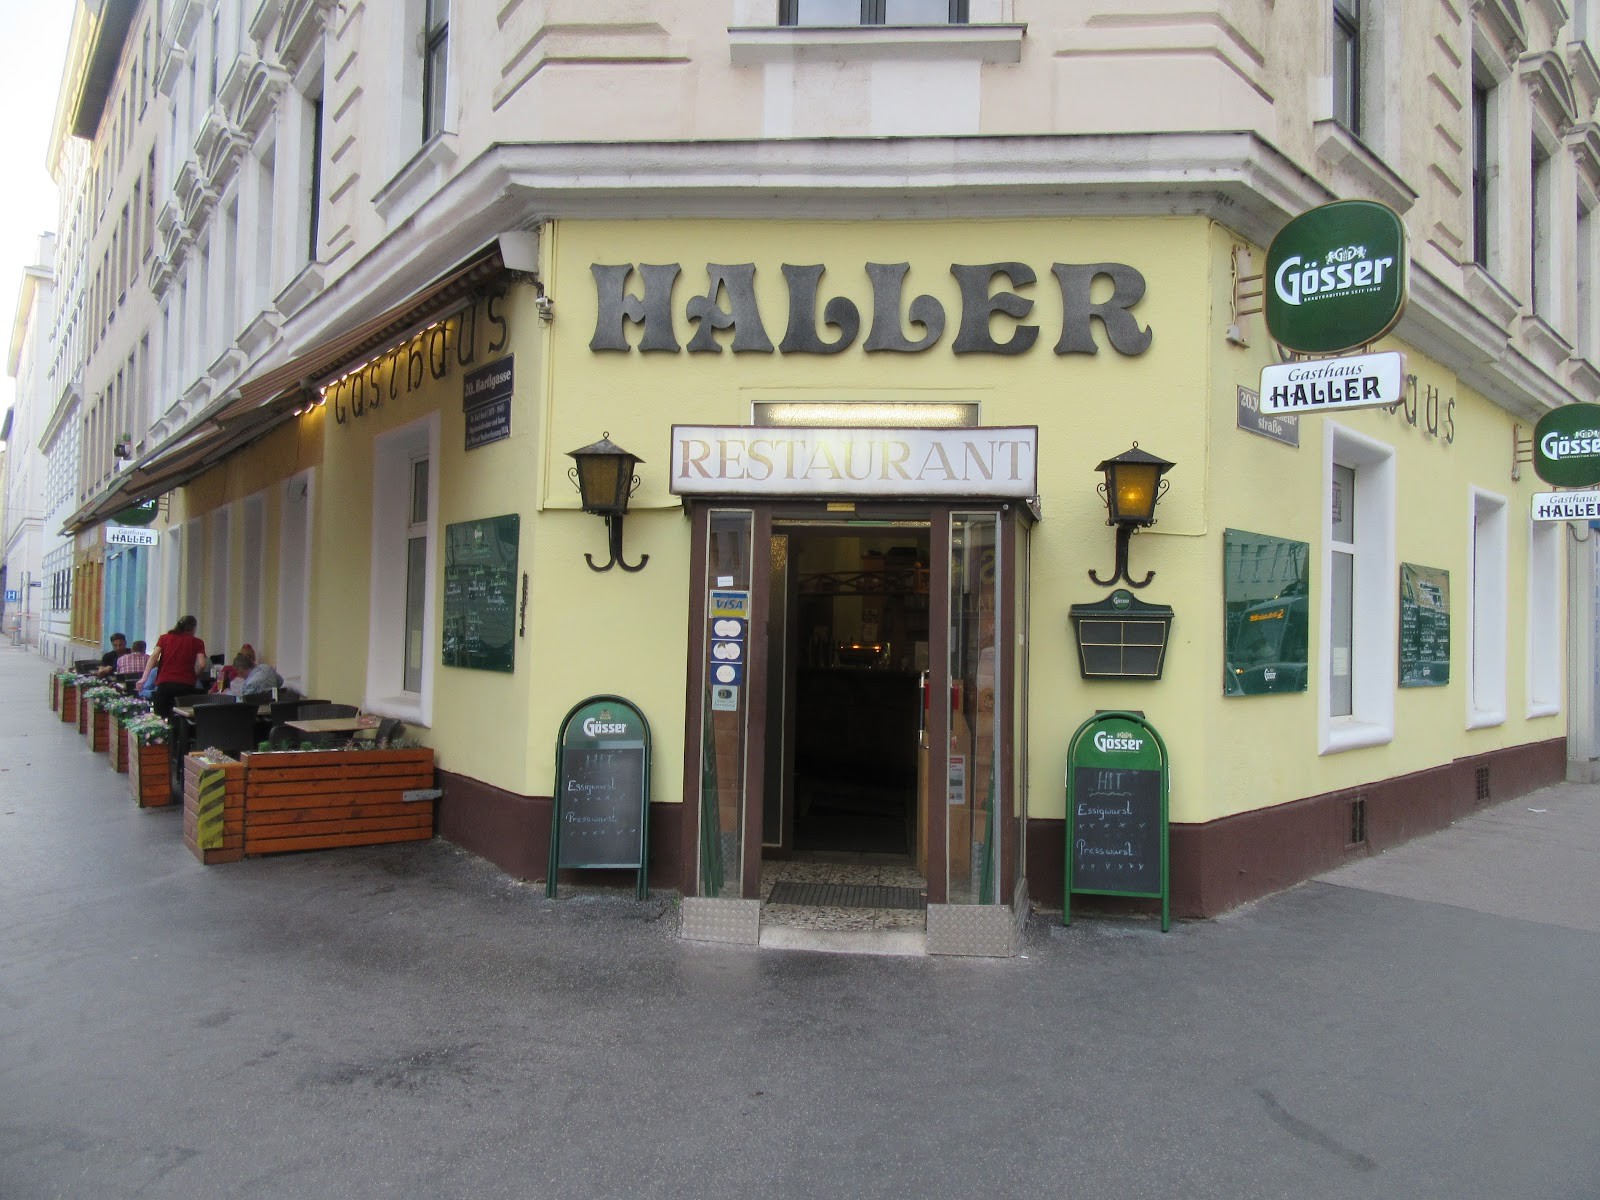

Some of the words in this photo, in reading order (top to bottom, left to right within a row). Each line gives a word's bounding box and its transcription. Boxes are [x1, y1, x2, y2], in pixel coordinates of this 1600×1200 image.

[1274, 256, 1393, 306] Gösser
[589, 262, 1153, 358] HALLER
[1288, 361, 1364, 382] Gasthaus
[1270, 376, 1381, 409] HALLER
[1258, 417, 1283, 435] straße
[678, 439, 1031, 481] RESTAURANT
[1549, 494, 1598, 504] Gasthaus
[111, 534, 152, 544] HALLER
[8, 591, 16, 600] H
[716, 599, 743, 610] VISA
[583, 717, 627, 737] Gösser
[1094, 731, 1143, 753] Gösser
[1097, 771, 1123, 790] HIT
[1077, 801, 1133, 820] Essigwurst
[1076, 838, 1134, 857] Presswurst
